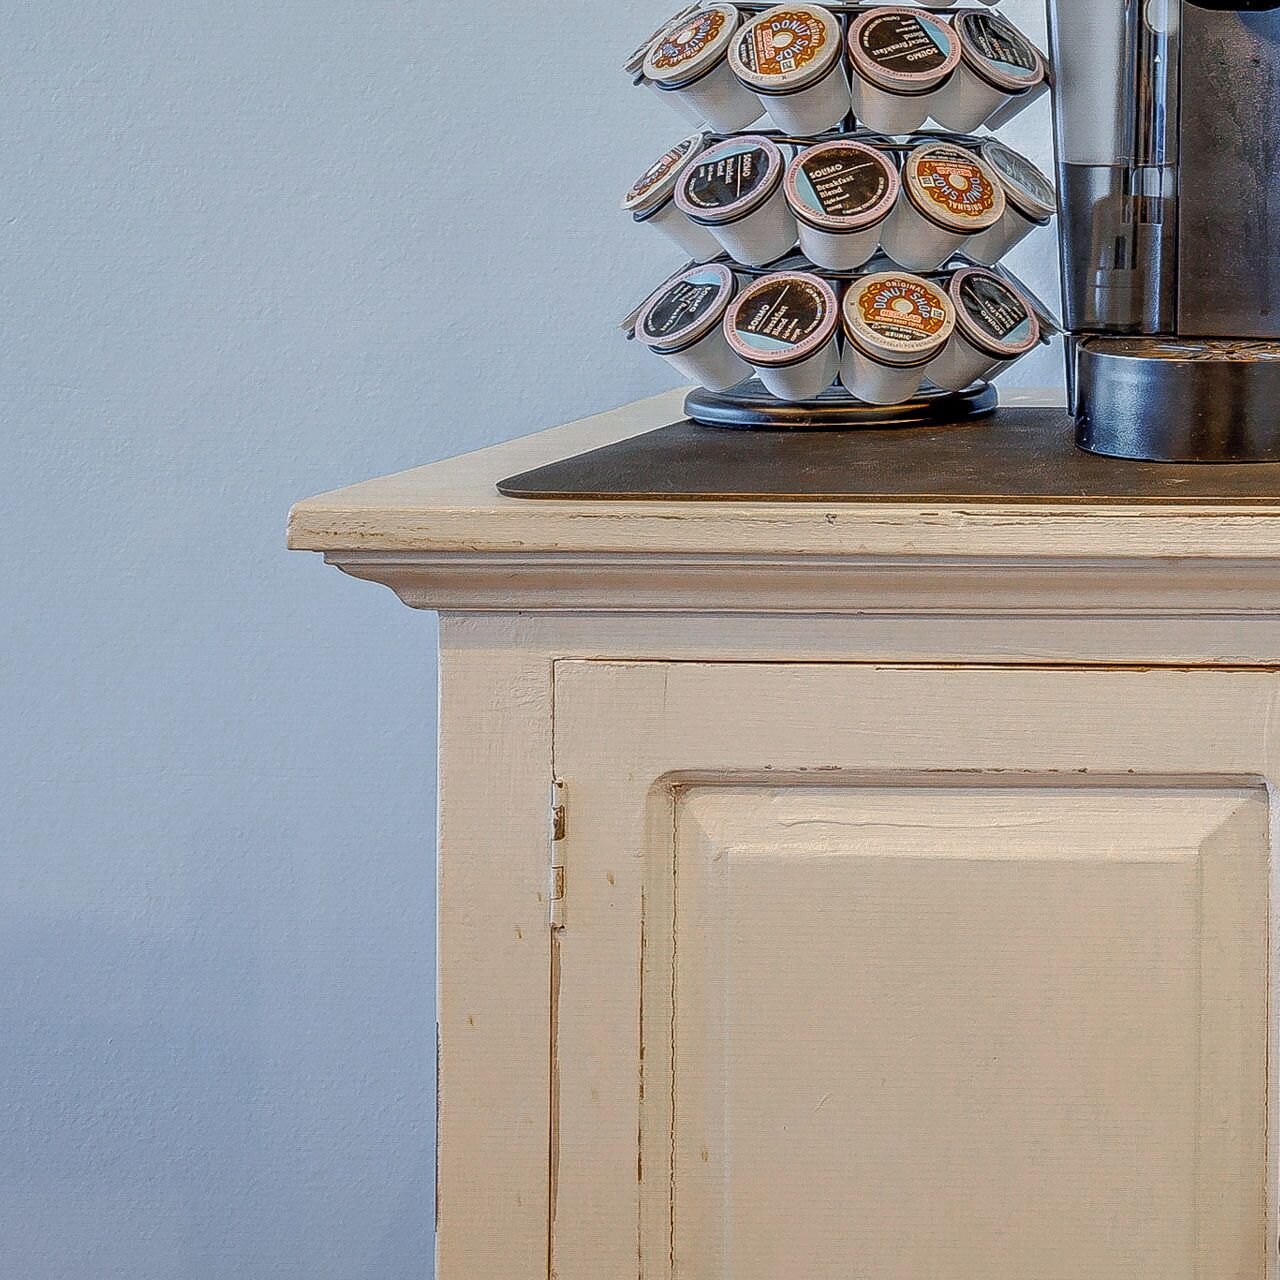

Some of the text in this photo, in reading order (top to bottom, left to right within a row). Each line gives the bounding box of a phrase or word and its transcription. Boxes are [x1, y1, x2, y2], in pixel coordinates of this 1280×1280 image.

[771, 19, 811, 61] DONUT SHOP
[872, 41, 910, 56] Breakfast
[906, 47, 938, 62] SOLIMO
[808, 163, 843, 179] SOLIMO
[815, 175, 855, 191] Breakfast
[932, 173, 983, 204] DONUT SHOP
[819, 186, 843, 198] Blend
[947, 199, 984, 211] ORIGINAL
[885, 281, 926, 295] ORIGINAL
[873, 287, 931, 318] DONUT SHOP
[747, 304, 770, 330] SOLIMO
[763, 305, 789, 334] Breakfast
[980, 309, 1004, 336] SOLIMO
[771, 317, 788, 336] Blend
[884, 330, 912, 341] KEURIG
